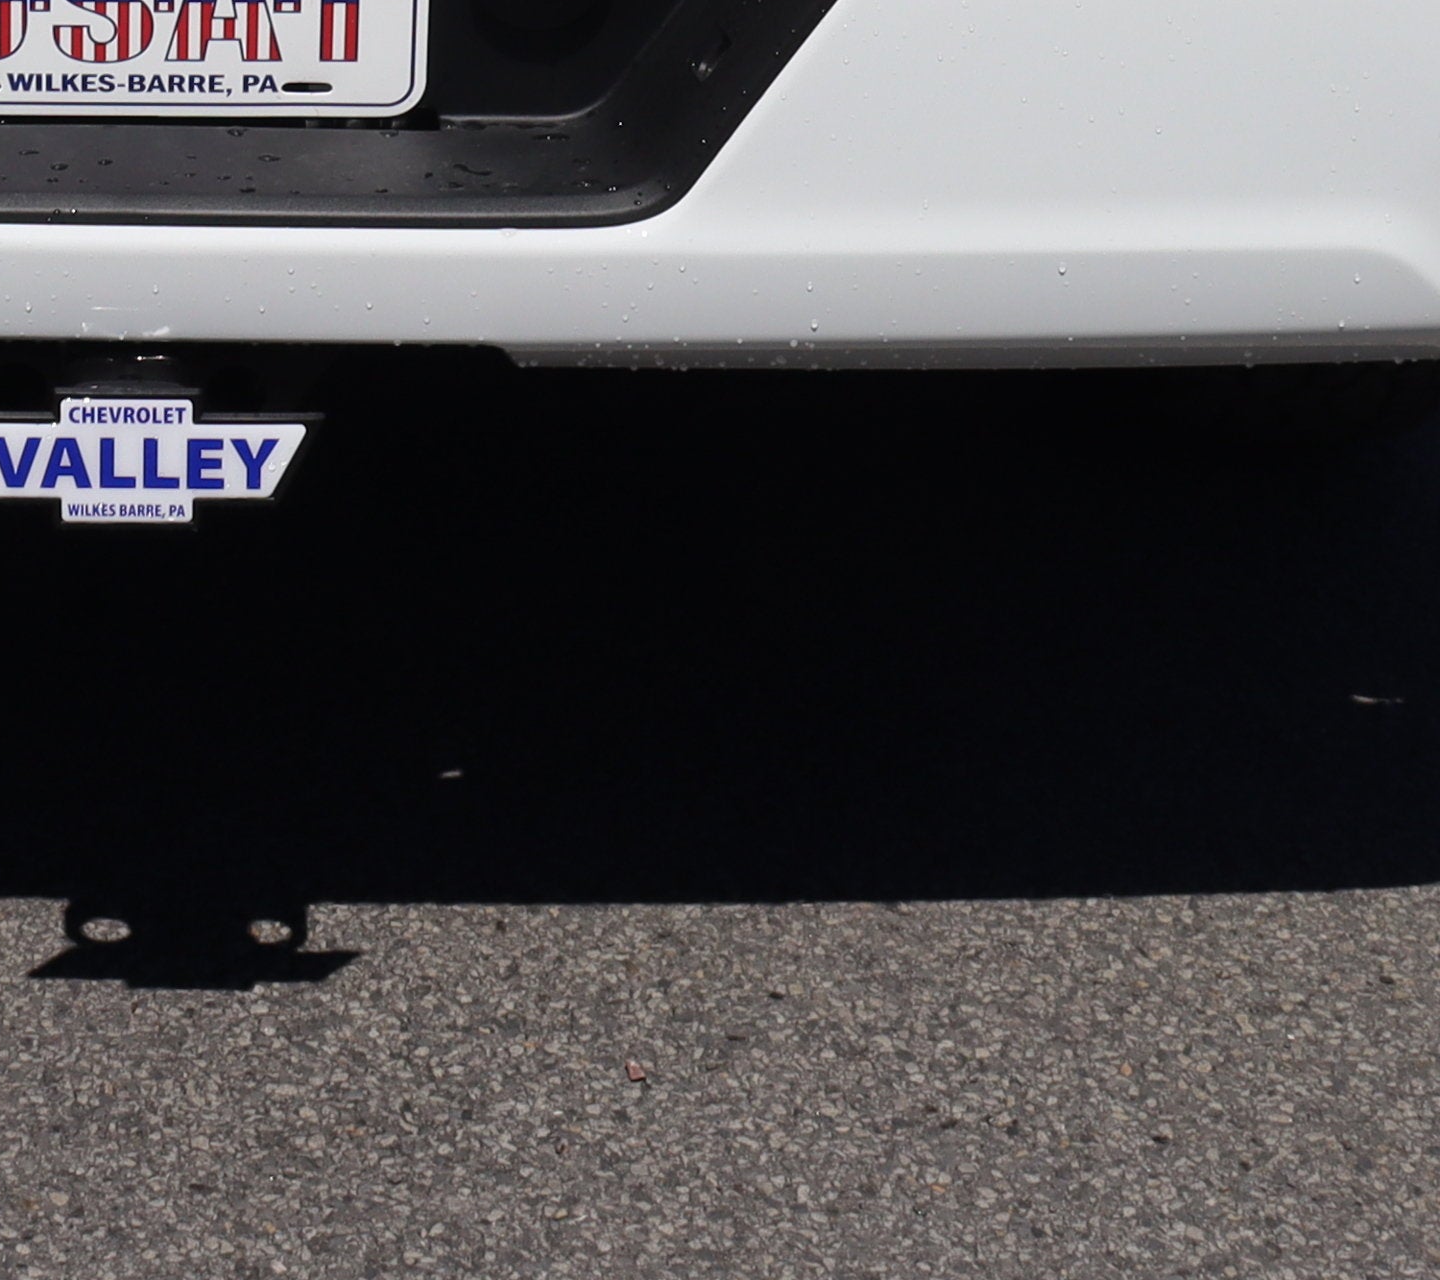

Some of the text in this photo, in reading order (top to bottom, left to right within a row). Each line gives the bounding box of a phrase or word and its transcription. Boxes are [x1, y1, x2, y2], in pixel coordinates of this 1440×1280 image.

[7, 73, 279, 97] WILKES-BARRE, PA
[68, 406, 187, 425] CHEVROLET
[67, 504, 187, 520] WILKES BARRE, PA
